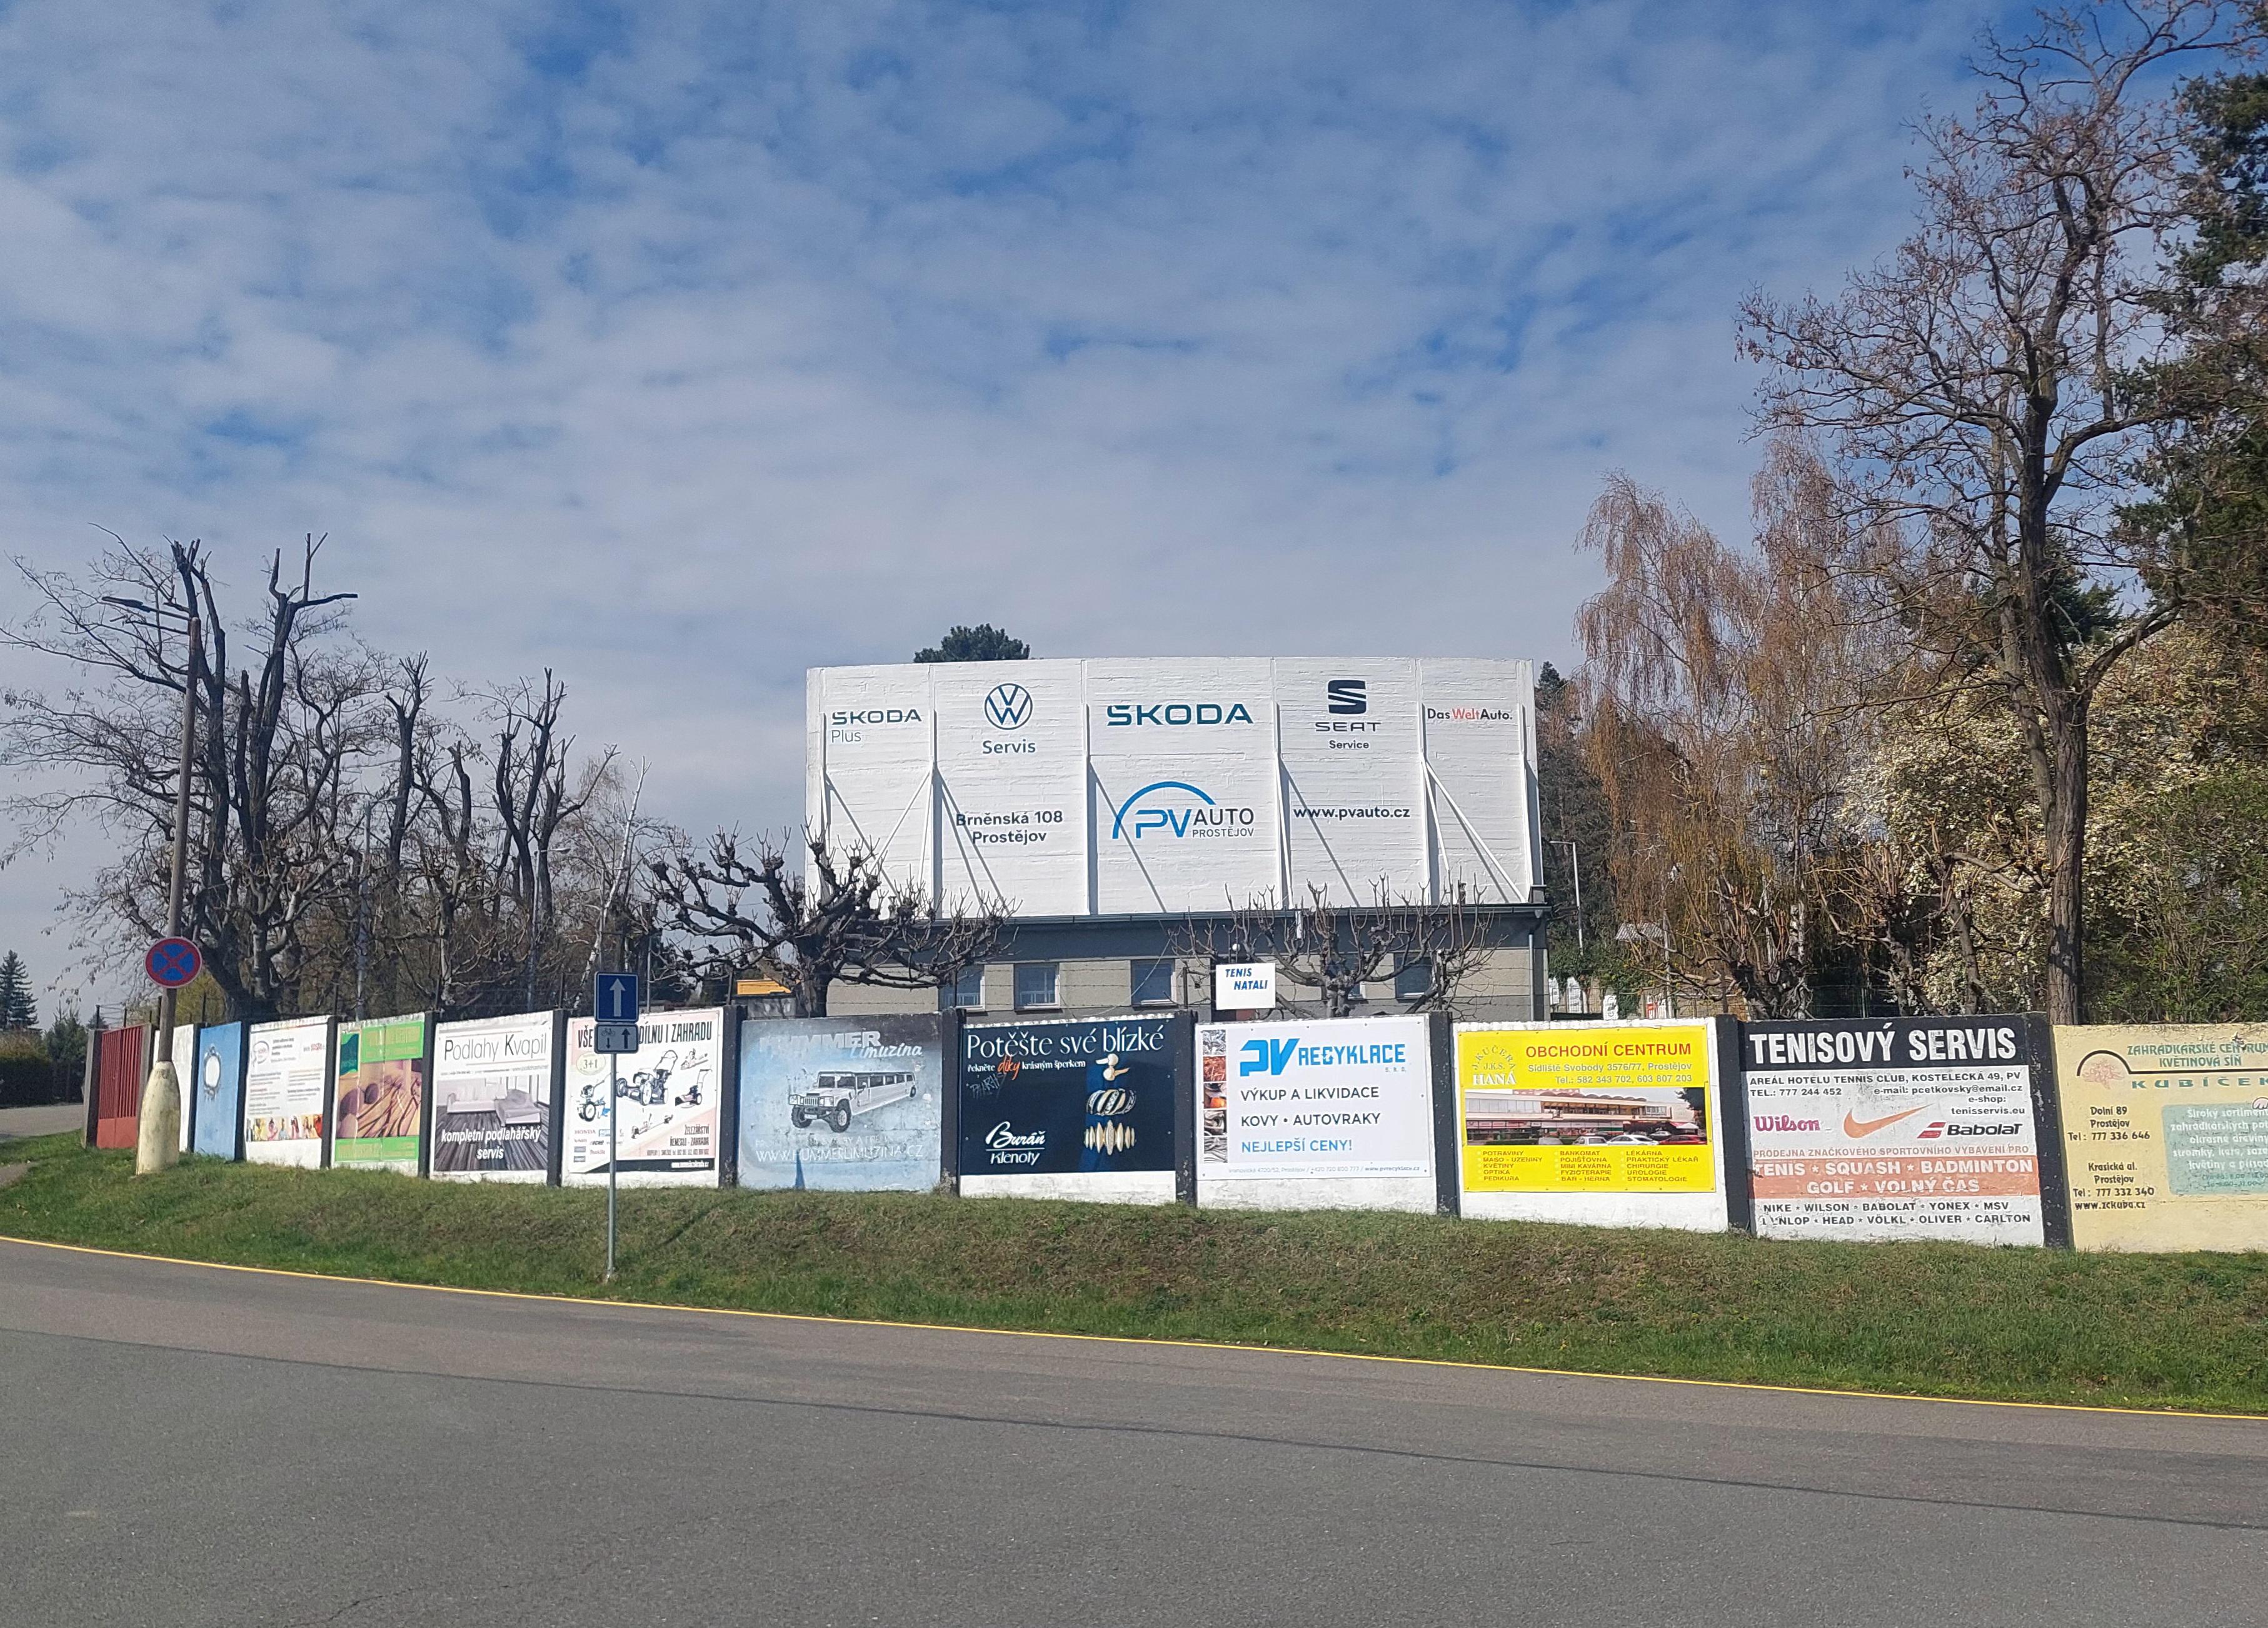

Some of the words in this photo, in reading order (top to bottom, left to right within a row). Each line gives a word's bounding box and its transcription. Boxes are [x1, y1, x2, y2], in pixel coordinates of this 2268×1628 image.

[1315, 721, 1382, 732] SEAT
[831, 729, 862, 743] Plus
[982, 738, 1036, 755] Servis
[1329, 740, 1370, 749] Service
[955, 812, 1030, 827] Brněnská
[1034, 810, 1063, 824] 108
[1293, 805, 1411, 820] www.pvauto.cz
[1135, 808, 1192, 839] PV
[1193, 808, 1255, 827] AUTO
[972, 830, 1047, 845] Prostějov
[1192, 827, 1255, 838] PROSTĚJOV
[1225, 968, 1253, 978] TENIS
[1233, 980, 1268, 990] NATALI
[578, 1025, 593, 1048] VŠE
[671, 1021, 713, 1042] ZAHRADU
[967, 1031, 1053, 1058] Potěšte
[1060, 1028, 1097, 1055] své
[1103, 1024, 1164, 1053] blízké
[444, 1037, 499, 1062] Podlahy
[504, 1032, 547, 1059] Kvapil
[759, 1031, 881, 1053] HMMER
[1749, 1022, 1895, 1064] TENISOVÝ
[1909, 1027, 2017, 1062] SERVIS
[2219, 1042, 2268, 1055] CENRU
[1525, 1042, 1608, 1058] OBCHODNÍ
[1613, 1043, 1692, 1056] CENTRUM
[1240, 1038, 1300, 1077] PV
[1298, 1043, 1407, 1066] RECYKLACE
[2159, 1055, 2220, 1068] KVĚTINOVÁ
[2224, 1053, 2242, 1066] SÍŇ
[1021, 1060, 1053, 1071] krásným
[1564, 1063, 1604, 1073] Svobody
[1648, 1062, 1692, 1072] Prostějov
[1473, 1070, 1517, 1086] HANÁ
[1615, 1075, 1635, 1083] 702,
[1637, 1075, 1653, 1083] 603
[1657, 1075, 1673, 1083] 807
[1750, 1074, 1785, 1085] AREÁL
[1787, 1076, 1830, 1085] HOTELU
[1834, 1075, 1874, 1084] TENNIS
[1876, 1074, 1909, 1083] CLUB,
[1912, 1071, 1985, 1082] KOSTELECKÁ
[1987, 1072, 2004, 1082] 49,
[2007, 1072, 2021, 1080] PV
[1240, 1087, 1287, 1102] VÝKUP
[1290, 1089, 1301, 1100] A
[1305, 1086, 1380, 1100] LIKVIDACE
[1750, 1088, 1776, 1097] TEL.:
[1874, 1085, 1909, 1094] e-mail:
[1912, 1084, 2023, 1095] pcetkovsky@email.cz
[1968, 1094, 2007, 1104] e-shop:
[1951, 1106, 2025, 1115] tenisservis.eu
[2090, 1107, 2113, 1115] Dolní
[2116, 1106, 2127, 1115] 89
[2187, 1107, 2218, 1119] Široký
[1241, 1115, 1279, 1127] KOVY
[1293, 1112, 1381, 1125] AUTOVRAKY
[1753, 1114, 1821, 1132] Wilson
[2090, 1118, 2130, 1129] Prostějov
[441, 1127, 485, 1145] kompletní
[484, 1125, 542, 1144] podlahářský
[985, 1121, 1046, 1148] Buráň
[2092, 1132, 2107, 1140] 777
[2132, 1131, 2150, 1139] 646
[2190, 1134, 2229, 1144] okrasné
[1241, 1137, 1307, 1153] NEJLEPŠÍ
[1310, 1139, 1353, 1152] CENY!
[1809, 1147, 1876, 1157] ZNAČKOVÉHO
[1879, 1145, 1952, 1155] SPORTOVNÍHO
[476, 1145, 505, 1160] servis
[990, 1151, 1040, 1166] Klenoty
[1755, 1163, 1806, 1176] TENIS
[1825, 1161, 1901, 1175] SQUASH
[1921, 1159, 2033, 1173] BADMINTON
[2088, 1162, 2124, 1171] Krasická
[2127, 1162, 2137, 1170] al.
[2189, 1159, 2225, 1170] květiny
[1807, 1181, 1855, 1193] GOLF
[1875, 1177, 1937, 1193] VOLNÝ
[1942, 1177, 1980, 1192] ČAS
[2094, 1174, 2134, 1185] Prostějov
[2096, 1188, 2111, 1197] 777
[2135, 1187, 2154, 1195] 340
[1804, 1203, 1850, 1212] WILSON
[1862, 1202, 1917, 1212] BABOLAT
[1929, 1202, 1970, 1210] YONEX
[1984, 1202, 2009, 1210] MSV
[2075, 1199, 2145, 1210] www.zckuba.cz
[1822, 1216, 1854, 1225] HEAD
[1867, 1214, 1906, 1224] VÖLKL
[1919, 1215, 1962, 1224] OLIVER
[1975, 1214, 2031, 1223] CARLTON
